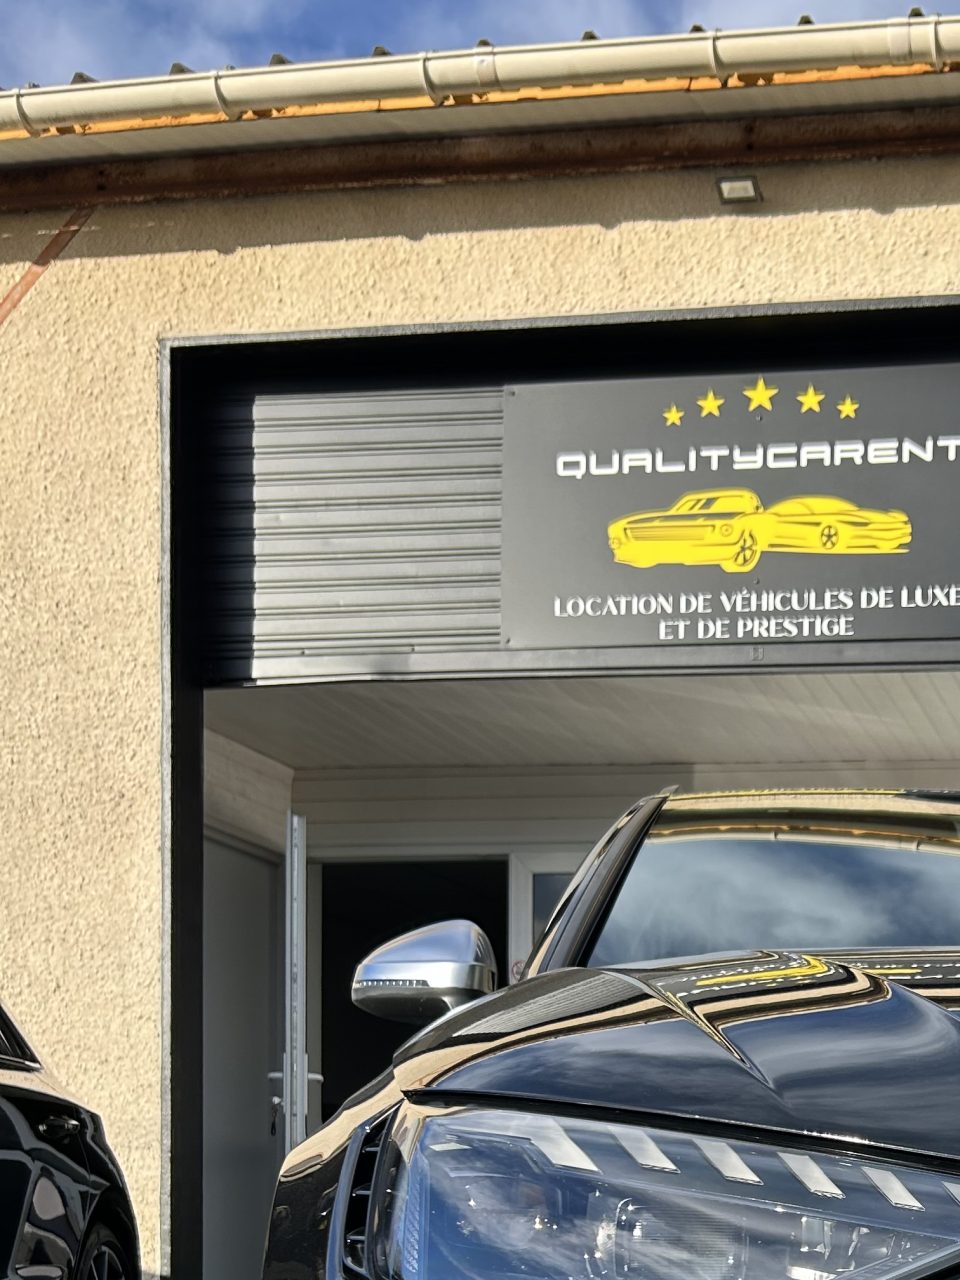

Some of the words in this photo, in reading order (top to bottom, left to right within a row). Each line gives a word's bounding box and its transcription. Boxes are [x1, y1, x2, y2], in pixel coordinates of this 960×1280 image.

[553, 593, 673, 617] LOCATION
[679, 591, 713, 613] DE
[719, 586, 854, 613] VÉHICULES
[860, 586, 894, 609] DE
[659, 617, 692, 640] ET
[697, 616, 731, 639] DE
[737, 613, 855, 638] PRESTIGE
